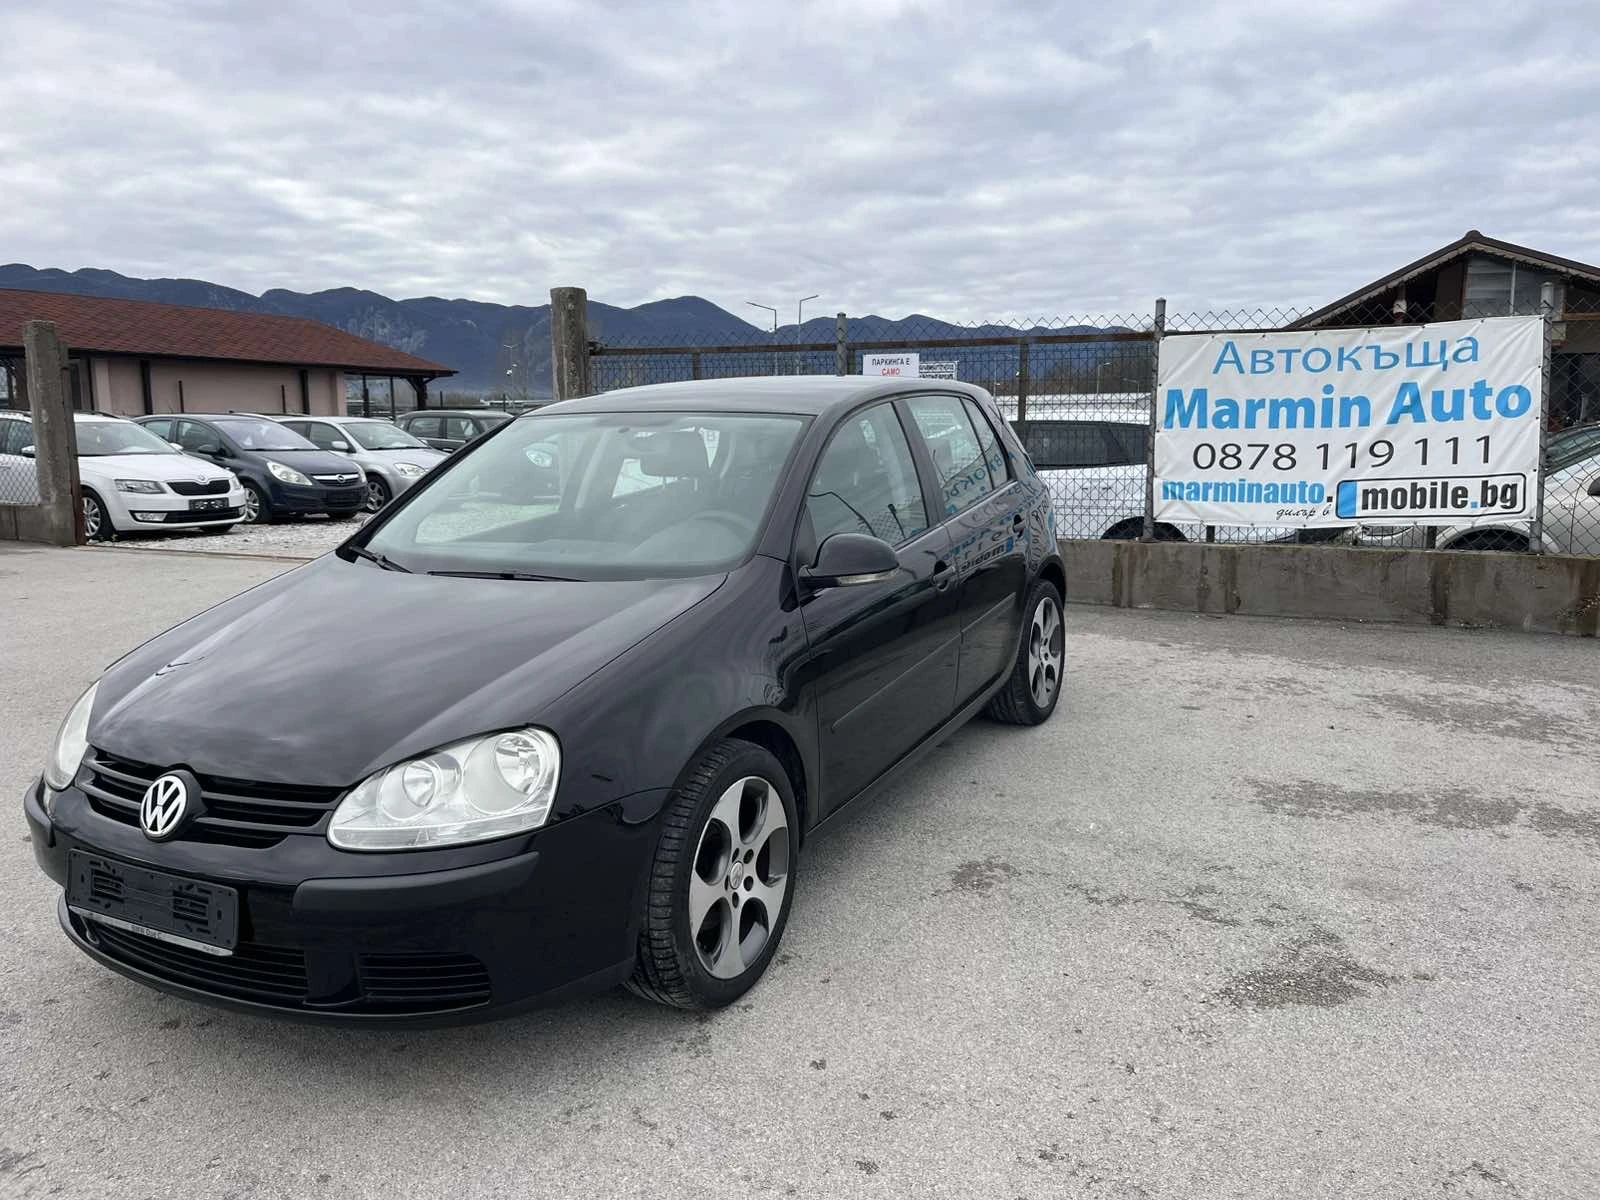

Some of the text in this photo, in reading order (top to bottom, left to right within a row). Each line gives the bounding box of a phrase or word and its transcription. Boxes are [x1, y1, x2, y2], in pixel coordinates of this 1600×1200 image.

[871, 358, 905, 366] ПАРКИНГА
[1212, 336, 1480, 375] Автокъща
[1164, 379, 1532, 430] Marmin Auto
[1193, 435, 1491, 471] 0878 119 111
[1361, 480, 1518, 510] mobile.bg
